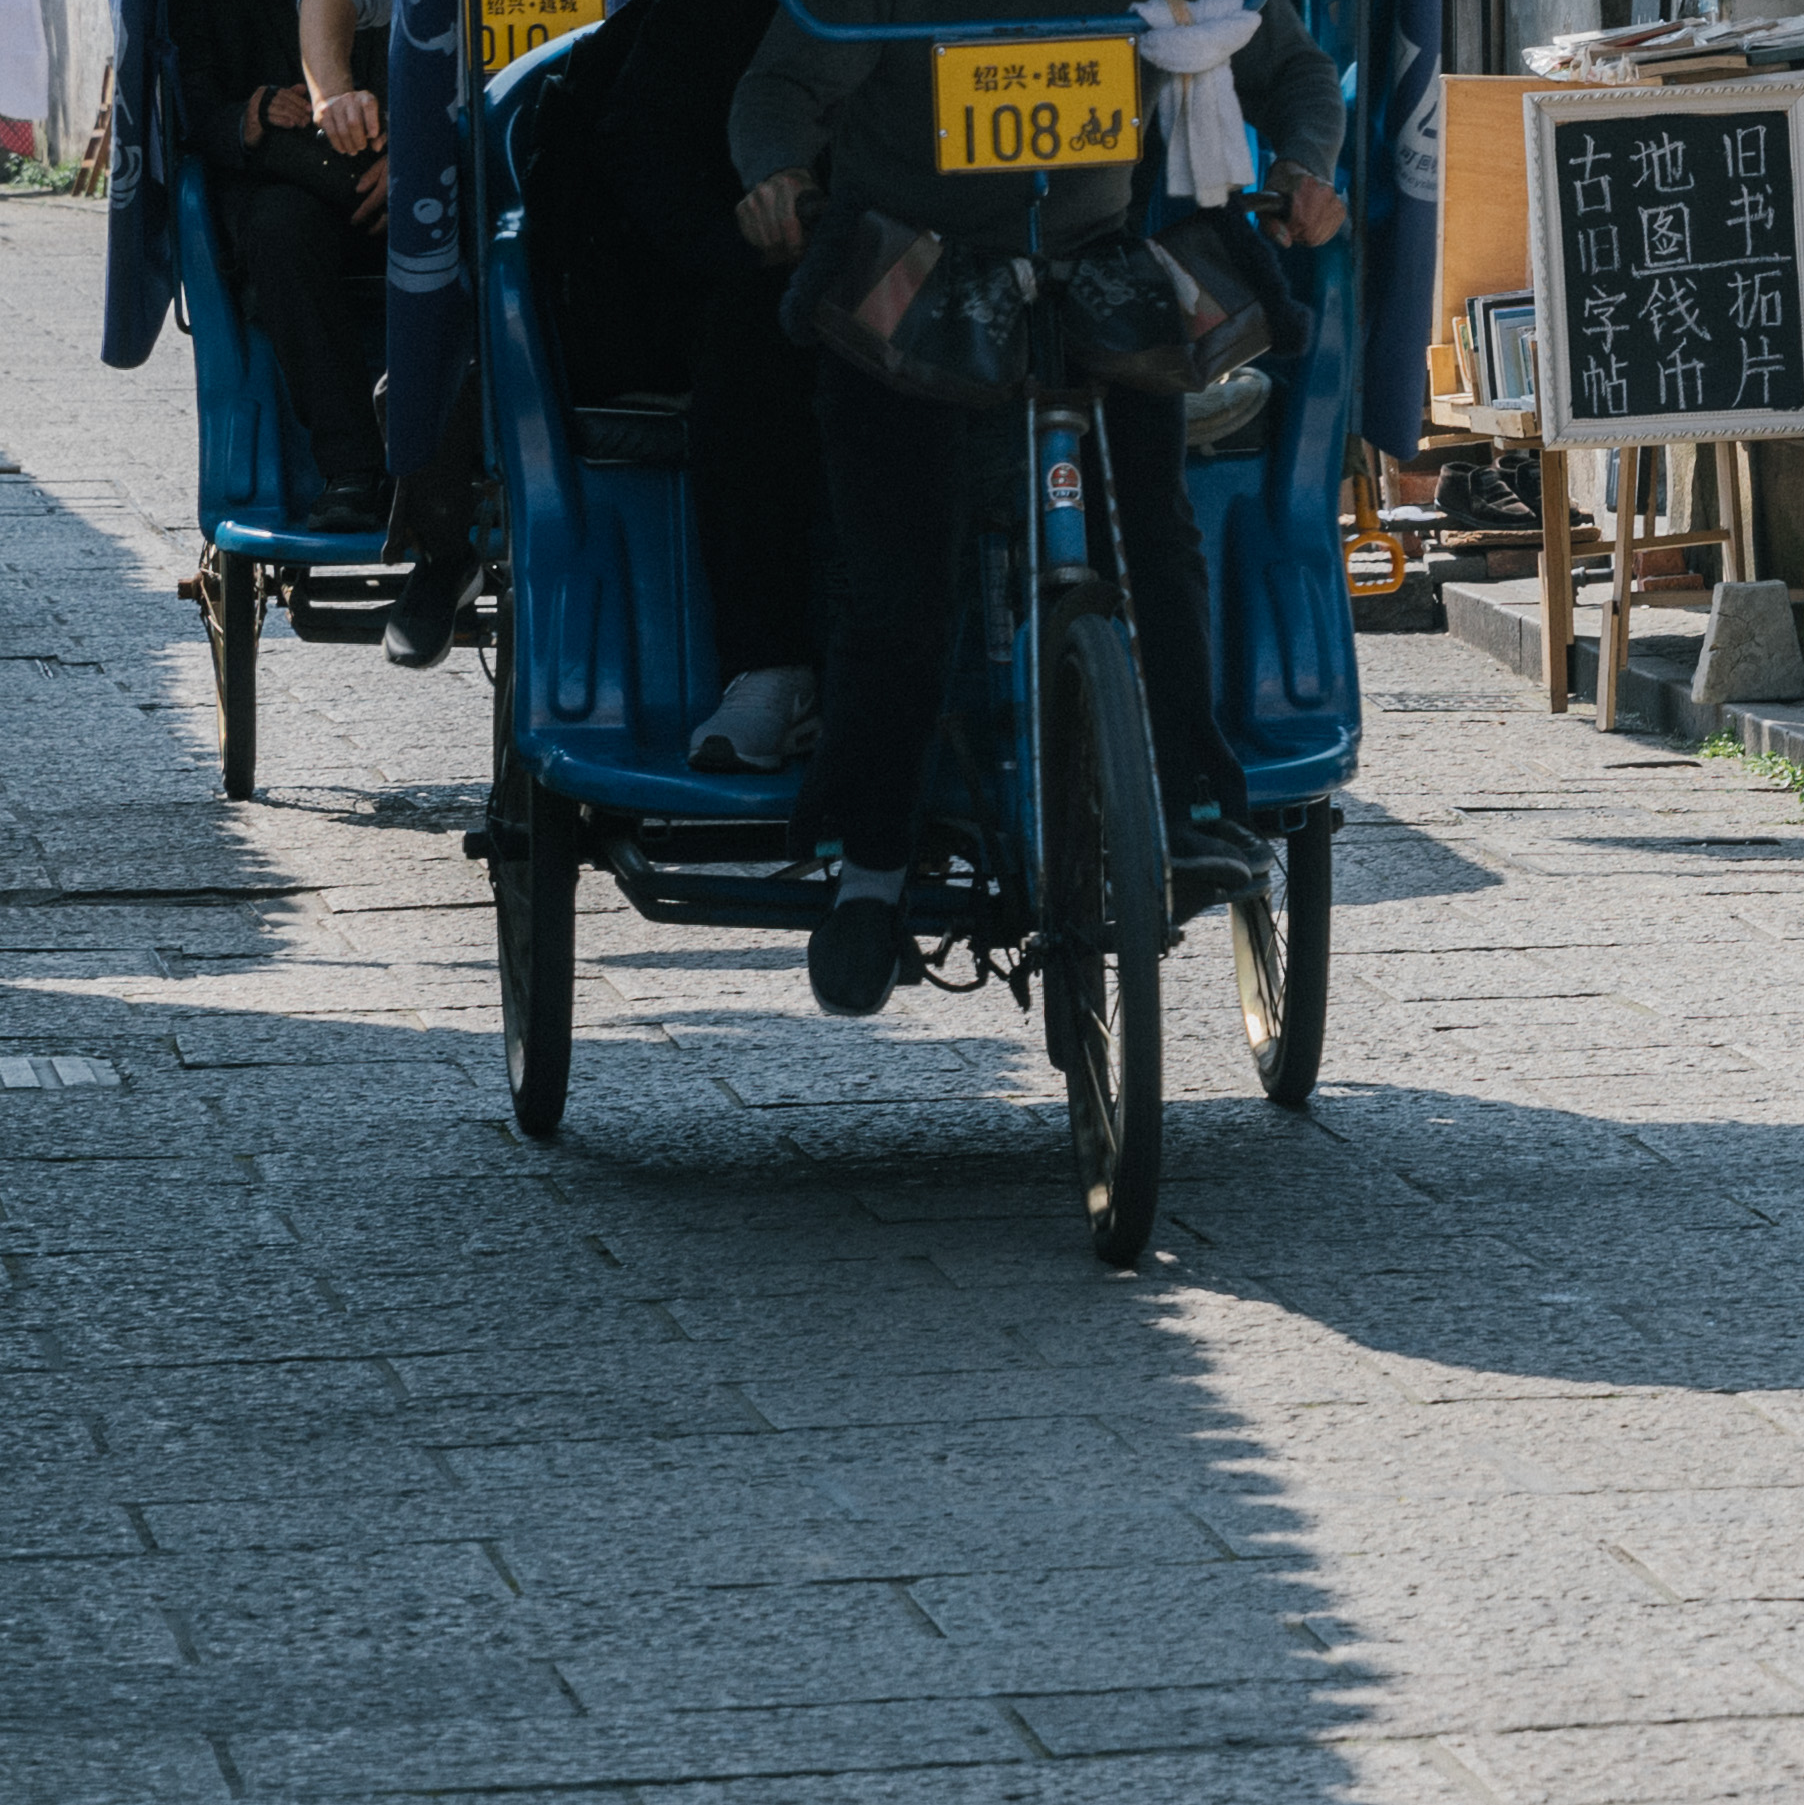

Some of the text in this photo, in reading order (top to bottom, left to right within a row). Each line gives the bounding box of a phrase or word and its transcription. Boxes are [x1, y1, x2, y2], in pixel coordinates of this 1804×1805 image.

[965, 102, 1062, 164] 108
[974, 60, 1102, 92] 绍兴·越城
[1629, 131, 1695, 269] 地图
[1724, 124, 1775, 256] 旧书
[1569, 133, 1631, 415] 古旧字帖
[1726, 270, 1786, 408] 拓片
[1637, 276, 1712, 411] 钱币
